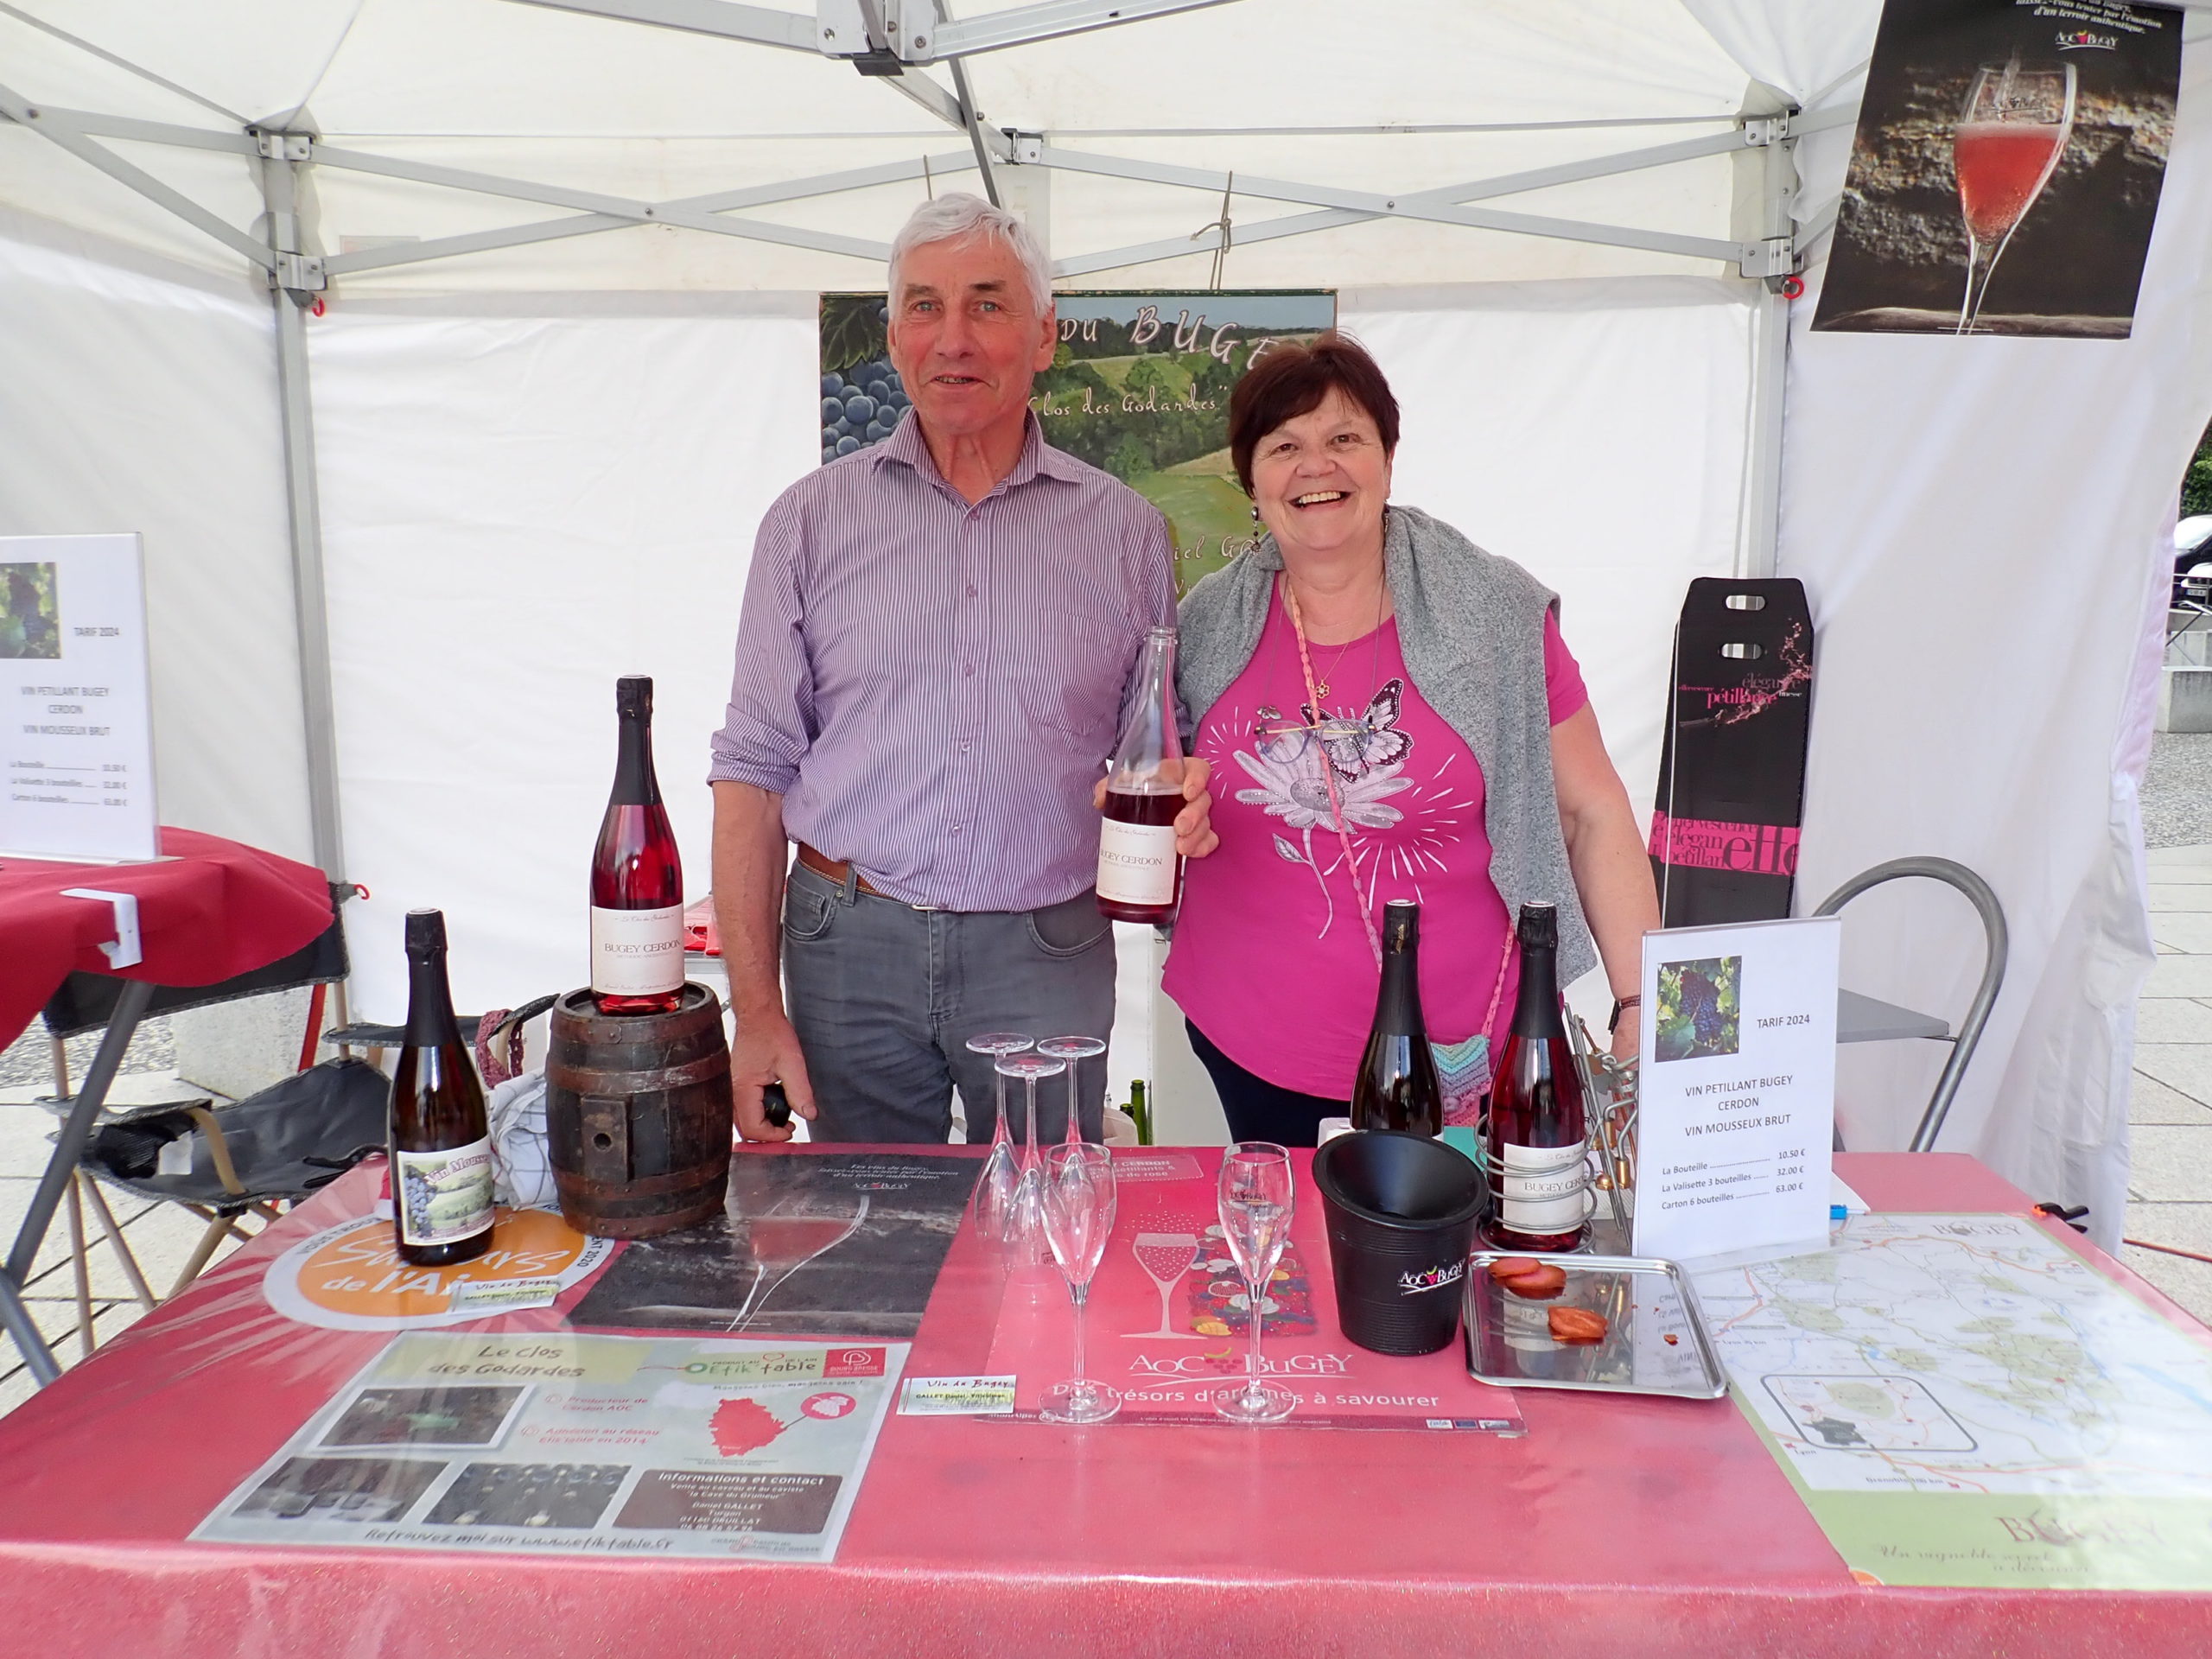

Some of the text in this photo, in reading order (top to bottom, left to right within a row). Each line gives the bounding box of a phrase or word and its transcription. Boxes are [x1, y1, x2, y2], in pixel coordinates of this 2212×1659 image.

[1059, 317, 1098, 342] DU
[1082, 387, 1110, 415] des
[73, 626, 97, 637] TARIF
[1122, 855, 1163, 866] CERDON
[605, 939, 681, 953] BUGEY CERDON
[1757, 1014, 1810, 1029] TARIF 2024
[1685, 1075, 1794, 1097] VIN PETILLANT BUGEY
[1718, 1096, 1760, 1111] CERDON
[1685, 1114, 1791, 1137] VIN MOUSSEUX BRUT
[1673, 1162, 1708, 1174] Bouteille
[1778, 1149, 1799, 1160] 10.50
[1800, 1148, 1806, 1157] €
[1524, 1181, 1564, 1192] BUGEY
[1673, 1180, 1707, 1191] Valisette
[1715, 1173, 1751, 1185] bouteilles
[1777, 1166, 1798, 1177] 32.00
[1662, 1182, 1804, 1210] Carton 6 bouteilles 63.00 €
[576, 1249, 601, 1268] 2020
[321, 1275, 367, 1294] de
[478, 1345, 510, 1358] Le
[429, 1362, 586, 1378] des Godardes
[1107, 1385, 1185, 1402] trésors
[1313, 1392, 1327, 1406] à
[1336, 1394, 1440, 1408] savourer
[658, 1472, 825, 1486] Informations et contact
